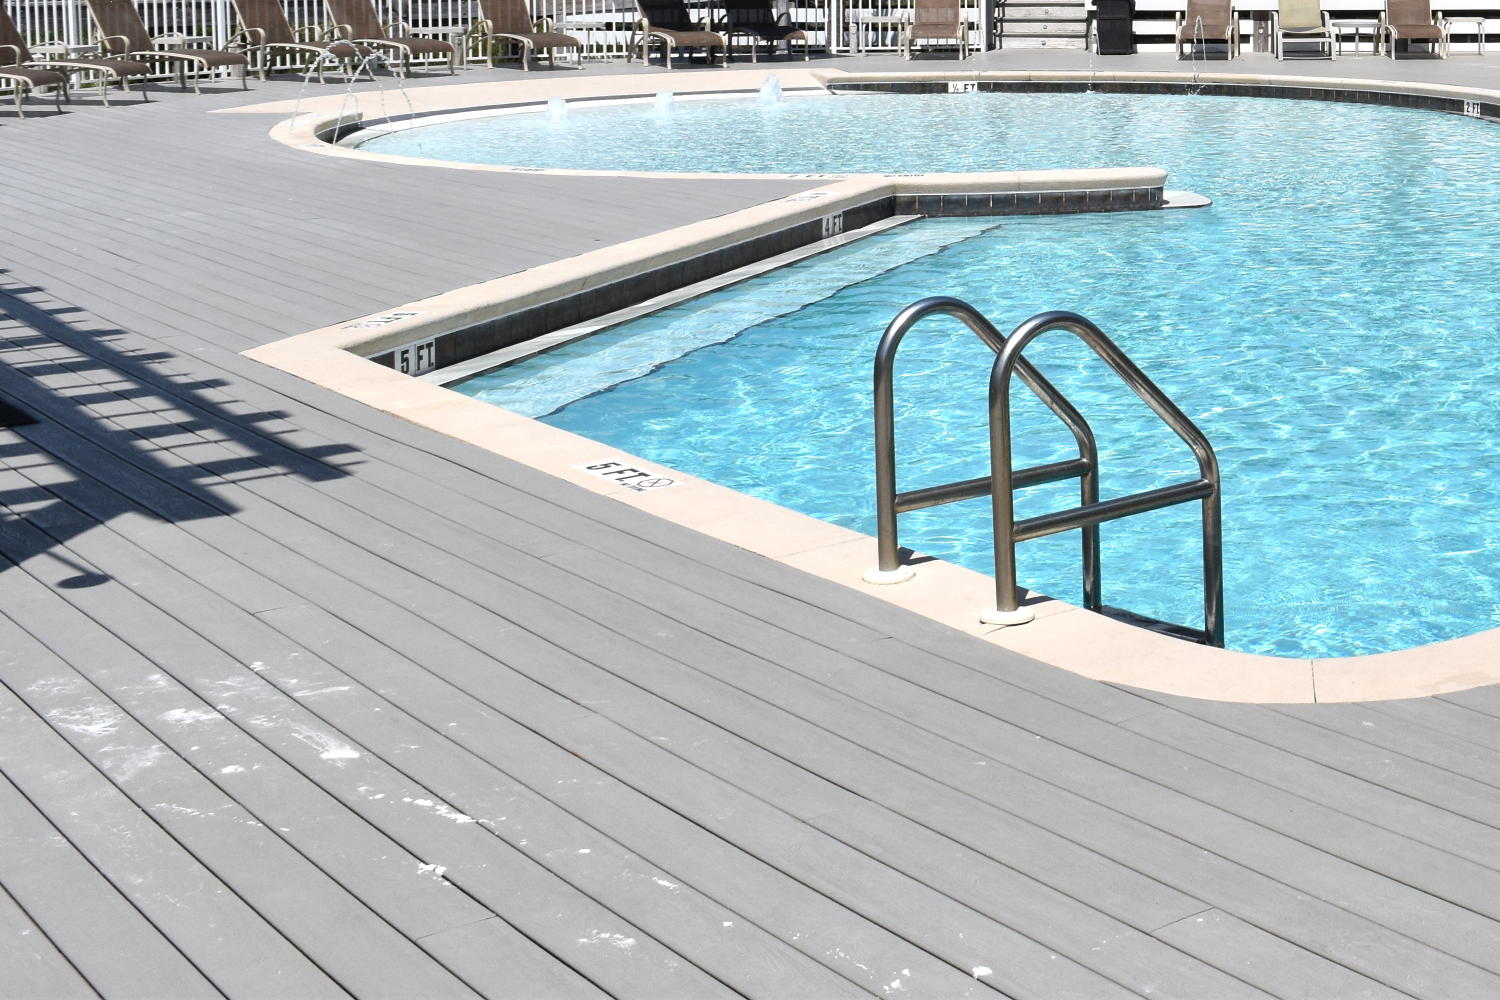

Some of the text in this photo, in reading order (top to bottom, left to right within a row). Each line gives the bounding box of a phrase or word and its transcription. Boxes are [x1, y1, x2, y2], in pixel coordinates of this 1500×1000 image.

[824, 216, 830, 236] 4
[400, 349, 410, 375] 5
[585, 462, 621, 471] 5
